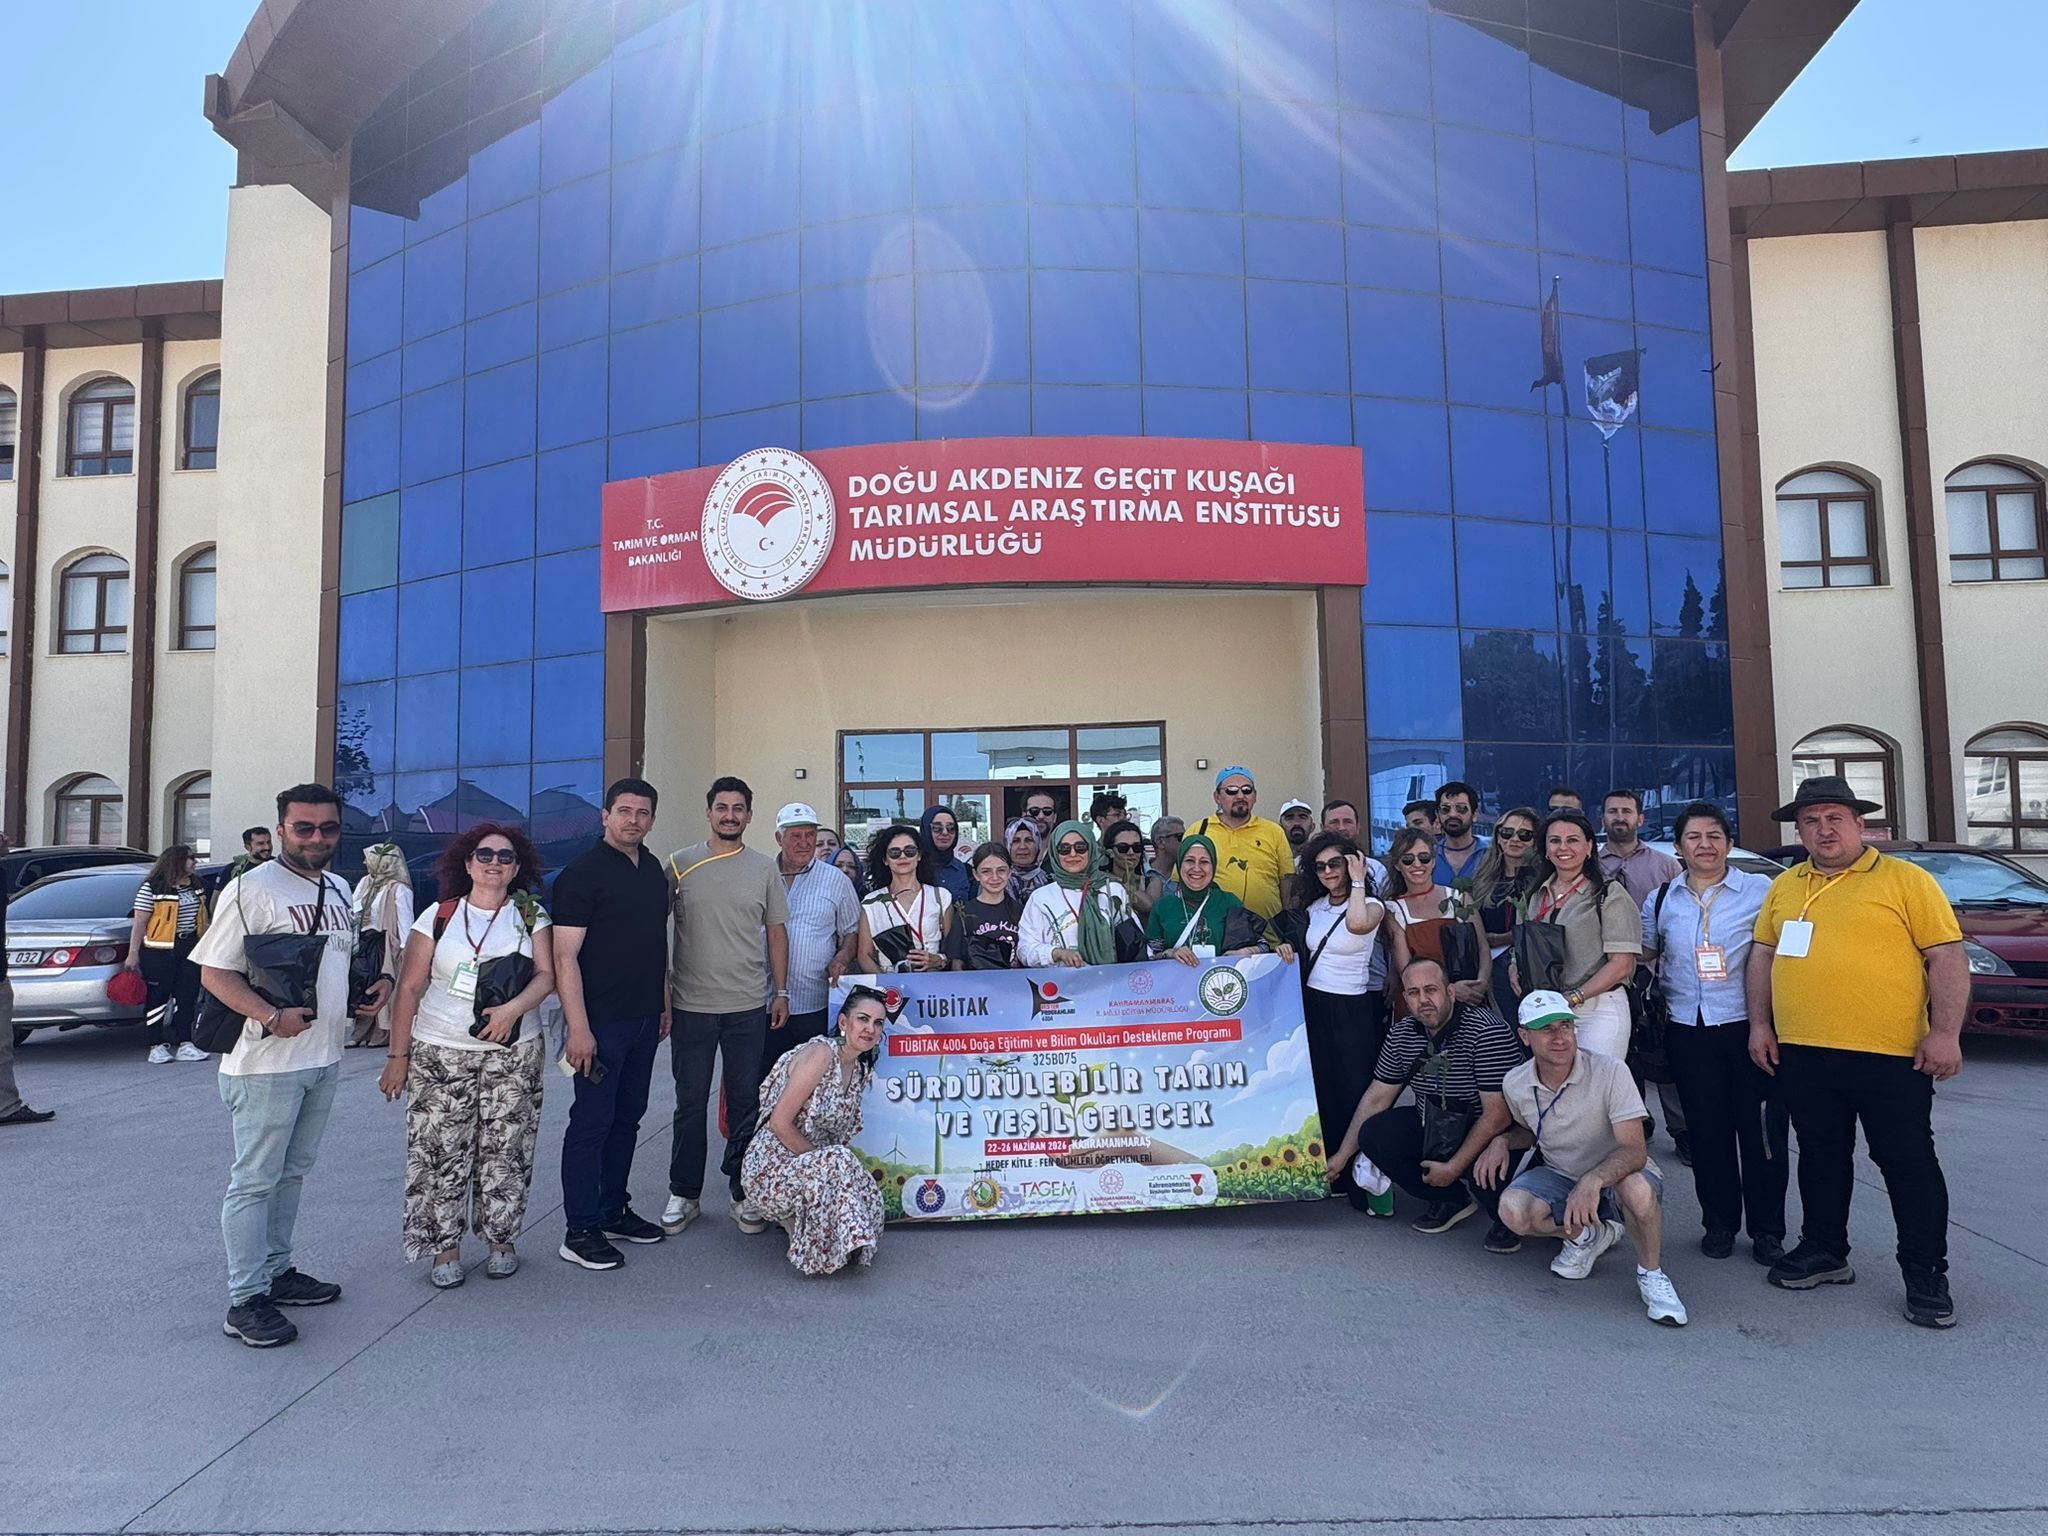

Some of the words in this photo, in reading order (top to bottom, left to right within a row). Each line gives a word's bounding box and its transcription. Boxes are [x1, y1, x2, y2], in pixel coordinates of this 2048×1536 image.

[848, 465, 937, 498] DOĞU
[947, 467, 1084, 491] AKDENİZ
[1094, 466, 1177, 496] GEÇİT
[1186, 465, 1295, 499] KUŞAĞI
[646, 518, 664, 530] T.C.
[849, 500, 999, 529] TARIMSAL
[1008, 498, 1184, 528] ARAŞTIRMA
[1196, 501, 1341, 528] ENSTİTÜSÜ
[612, 538, 643, 552] TARIM
[645, 536, 658, 548] VE
[659, 530, 698, 546] ORMAN
[849, 525, 1042, 562] MÜDÜRLÜĞÜ
[628, 549, 682, 567] BAKANLIĞI
[287, 904, 354, 933] NIRVAN
[973, 922, 998, 935] ello
[15, 952, 39, 963] 032
[916, 993, 990, 1019] TÜBİTAK
[899, 1037, 941, 1053] TÜBİTAK
[942, 1038, 967, 1052] 4004
[970, 1037, 995, 1053] Doğa
[998, 1035, 1033, 1051] Eğitimi
[1035, 1038, 1048, 1048] ve
[1050, 1033, 1077, 1047] Bilim
[1079, 1031, 1120, 1046] Okulları
[1123, 1029, 1183, 1043] Destekleme
[1185, 1027, 1232, 1042] Programı
[1033, 1053, 1077, 1066] 325B075
[886, 1062, 1141, 1101] SÜRDÜRÜLEBİLİR
[1154, 1061, 1247, 1091] TARIM
[936, 1111, 971, 1137] VE
[984, 1102, 1069, 1137] YEŞİL
[1082, 1100, 1213, 1131] GELECEK
[987, 1142, 1011, 1153] 22-26
[1012, 1140, 1047, 1152] HAZİRAN
[985, 1159, 1010, 1170] HEDEF
[1011, 1156, 1033, 1169] KİTLE
[1039, 1157, 1055, 1167] FEN
[1095, 1153, 1153, 1165] ÖĞRETMENLERİ
[1020, 1180, 1077, 1197] TAGEM
